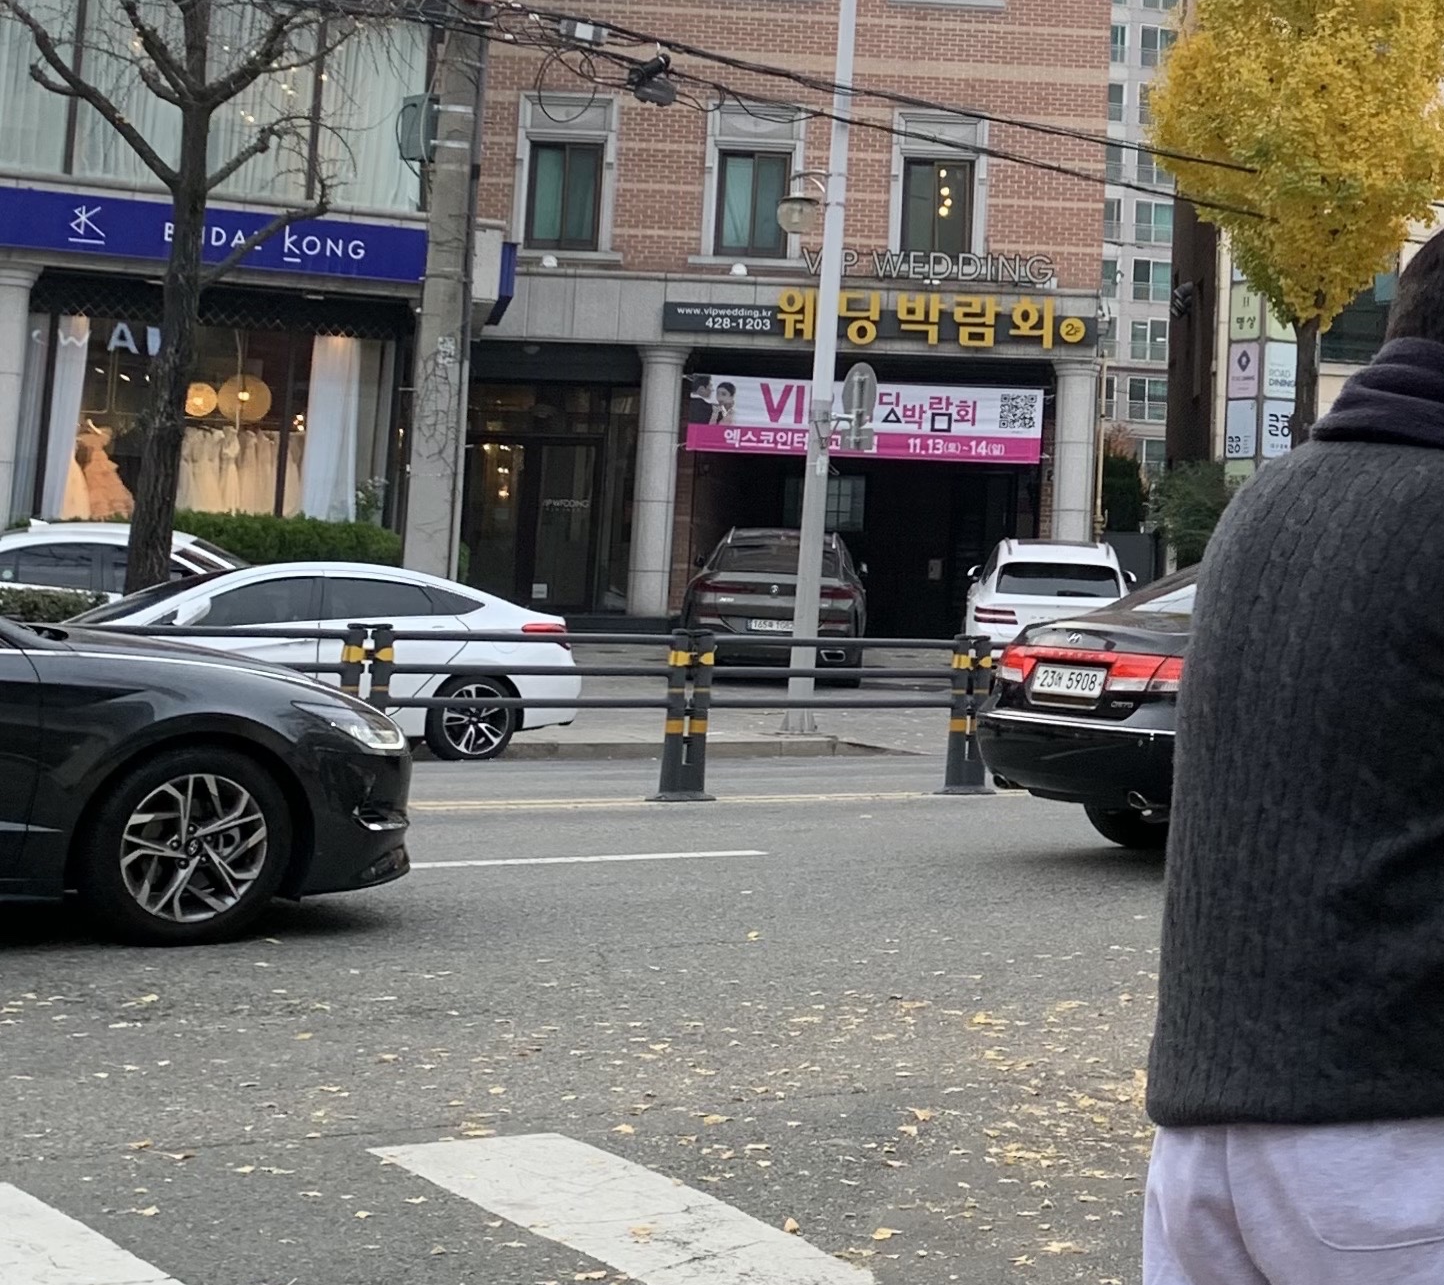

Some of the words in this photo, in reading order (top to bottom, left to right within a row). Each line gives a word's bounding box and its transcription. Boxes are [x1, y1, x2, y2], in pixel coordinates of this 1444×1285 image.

[802, 247, 859, 276] VP
[871, 250, 1055, 284] WEDDING
[677, 306, 773, 318] www.vipwedding.kr
[705, 317, 771, 330] 428-1203
[1066, 671, 1097, 691] 5908
